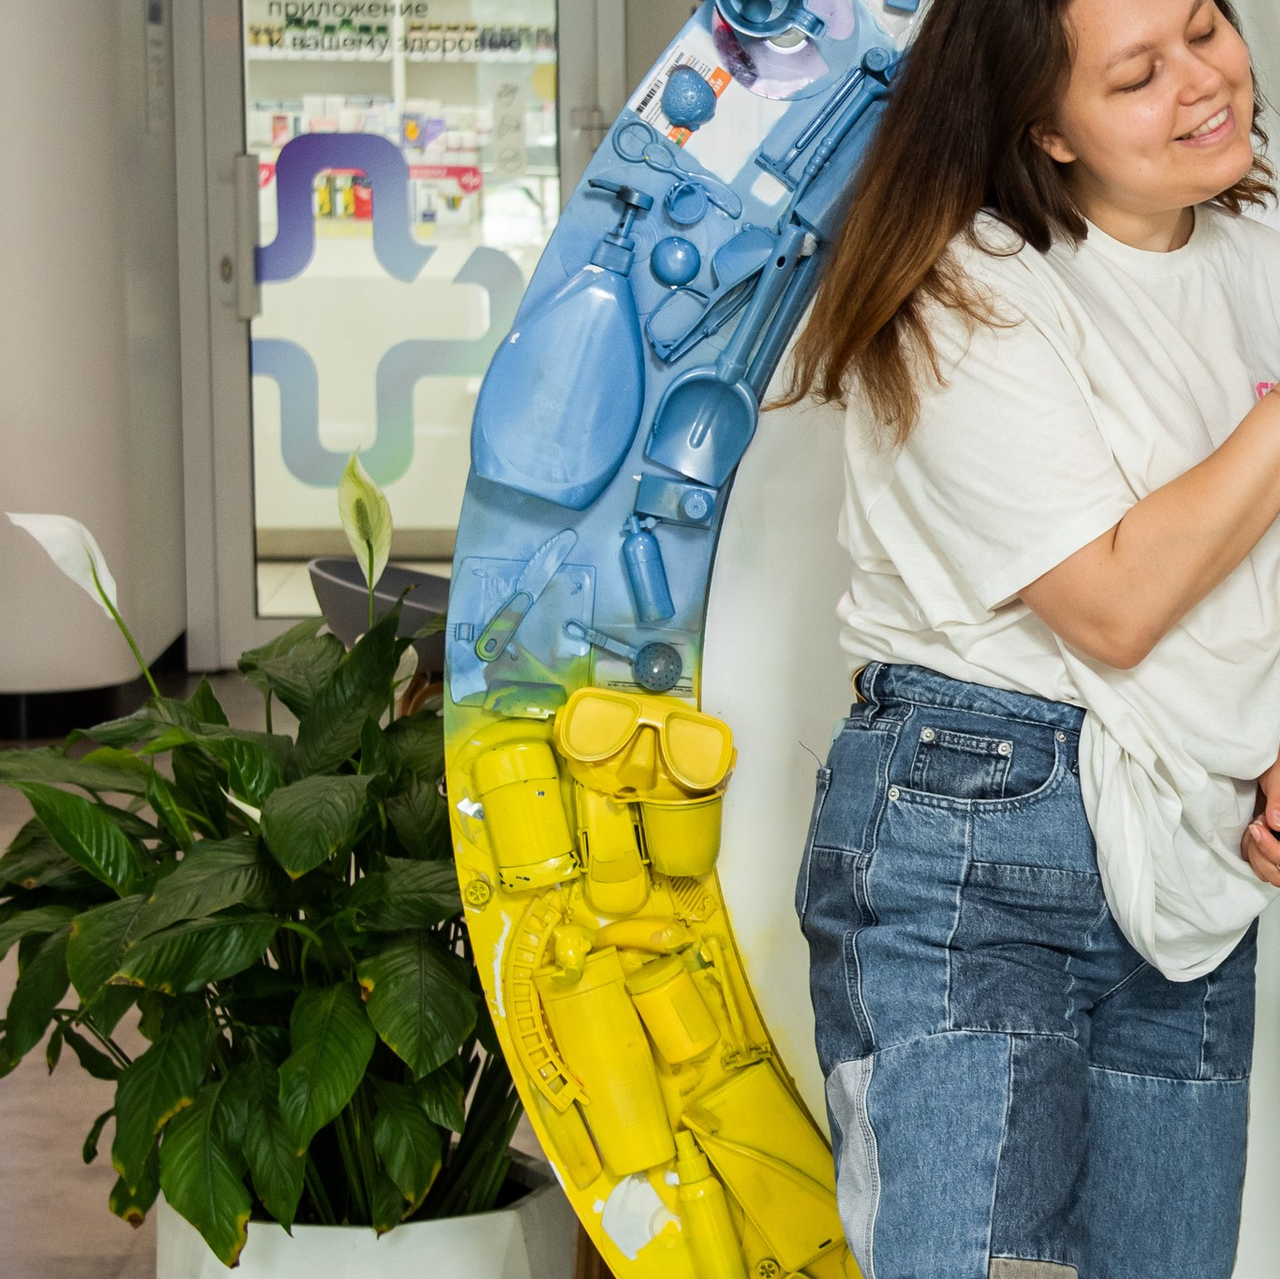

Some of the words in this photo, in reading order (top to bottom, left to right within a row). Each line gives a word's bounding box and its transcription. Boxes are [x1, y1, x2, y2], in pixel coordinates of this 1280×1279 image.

[268, 1, 428, 23] приложение
[292, 35, 389, 55] вашему
[397, 35, 521, 55] здоровью
